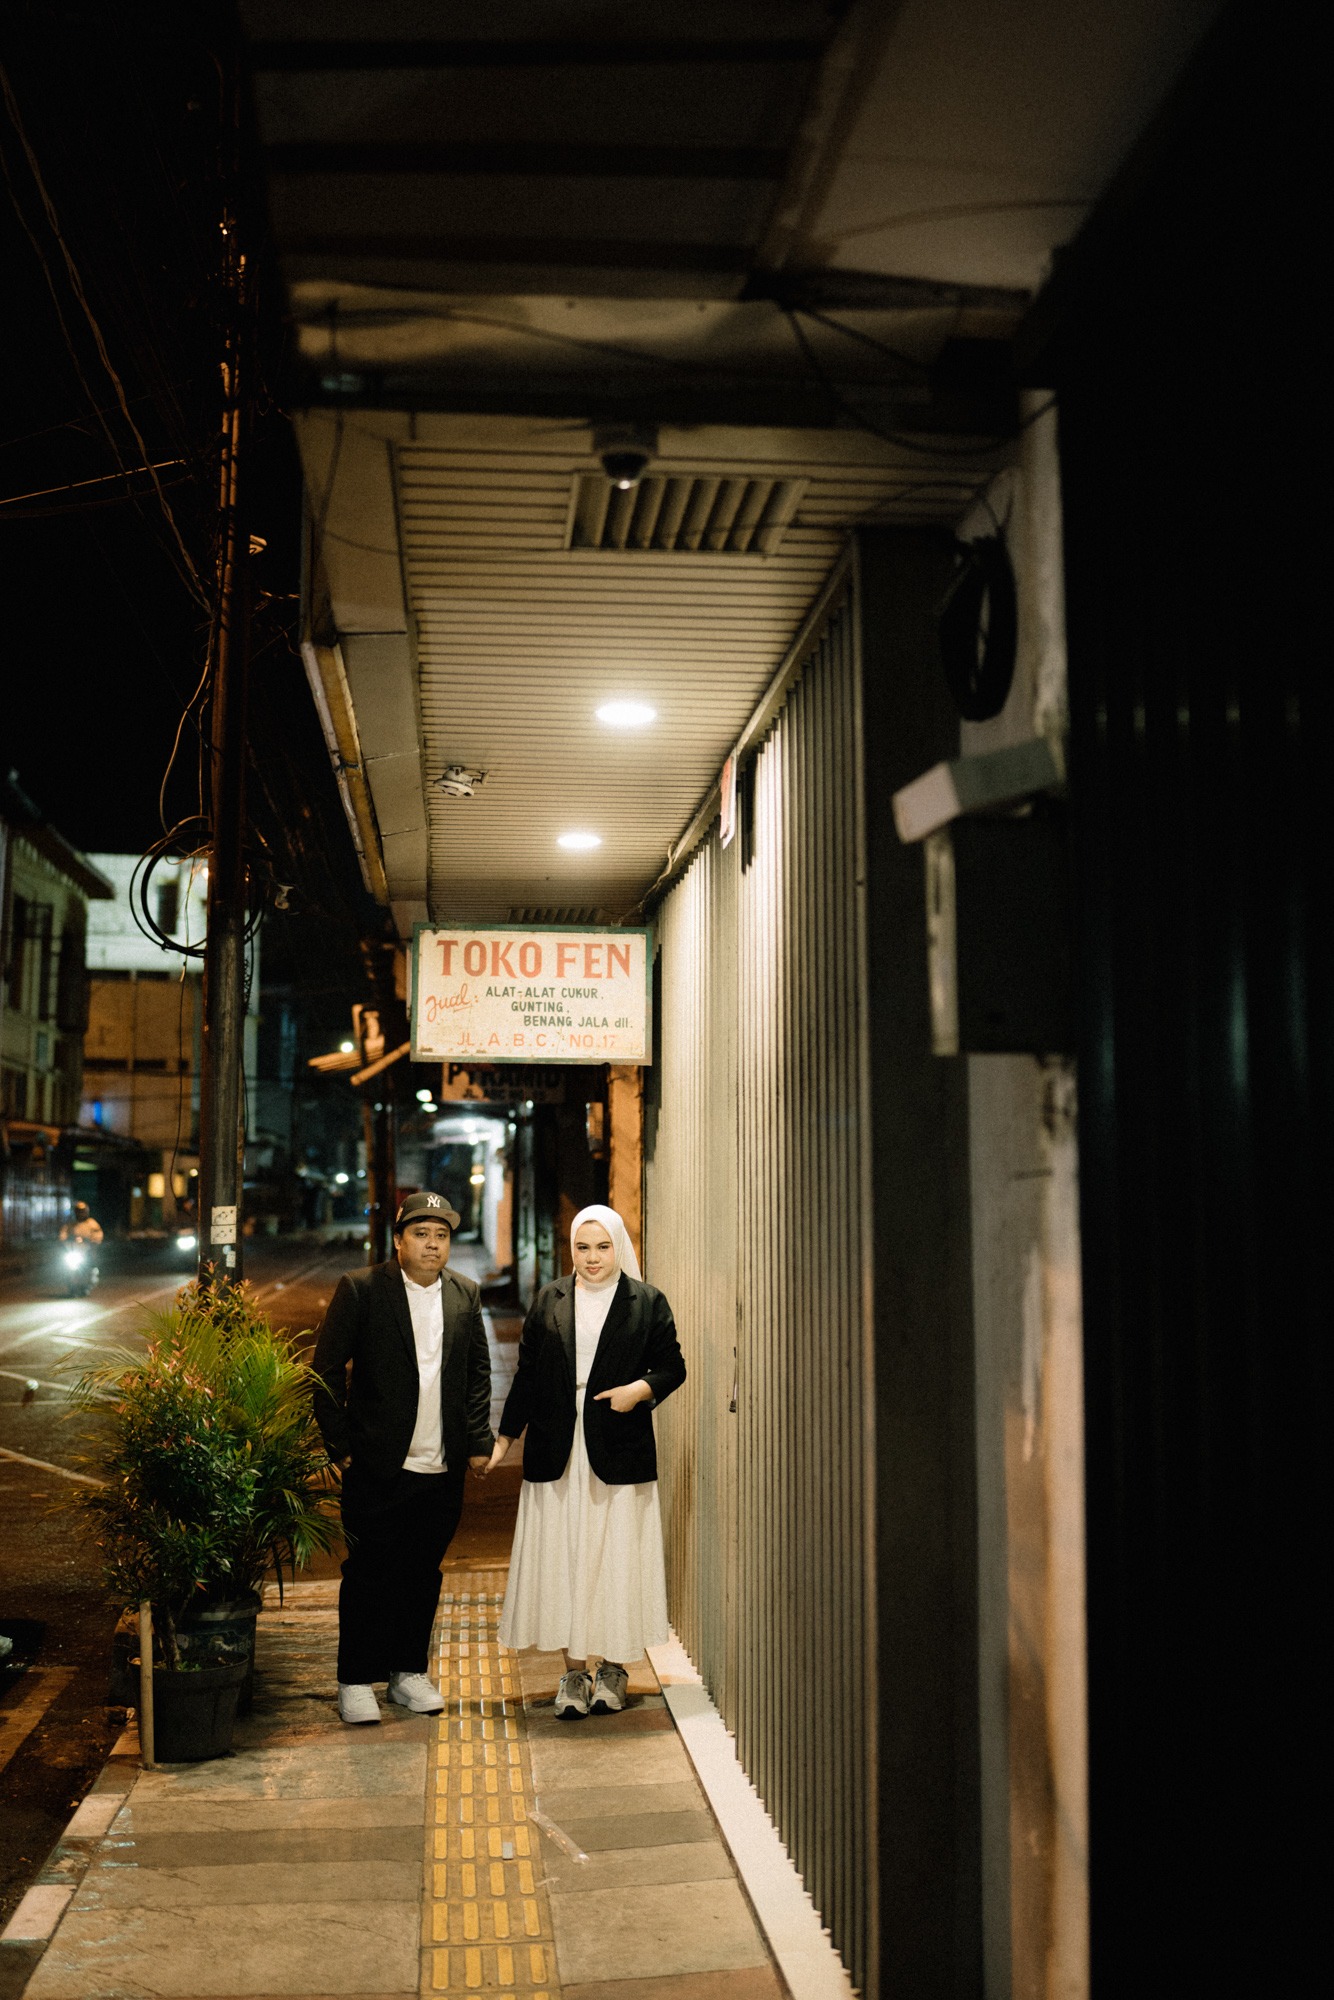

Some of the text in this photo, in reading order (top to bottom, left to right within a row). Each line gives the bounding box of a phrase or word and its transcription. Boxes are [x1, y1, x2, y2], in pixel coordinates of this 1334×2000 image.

[436, 940, 631, 979] TOKO FEN
[485, 986, 556, 998] ALAT-ALAT
[523, 1015, 573, 1027] BENANG
[578, 1017, 609, 1028] JALA
